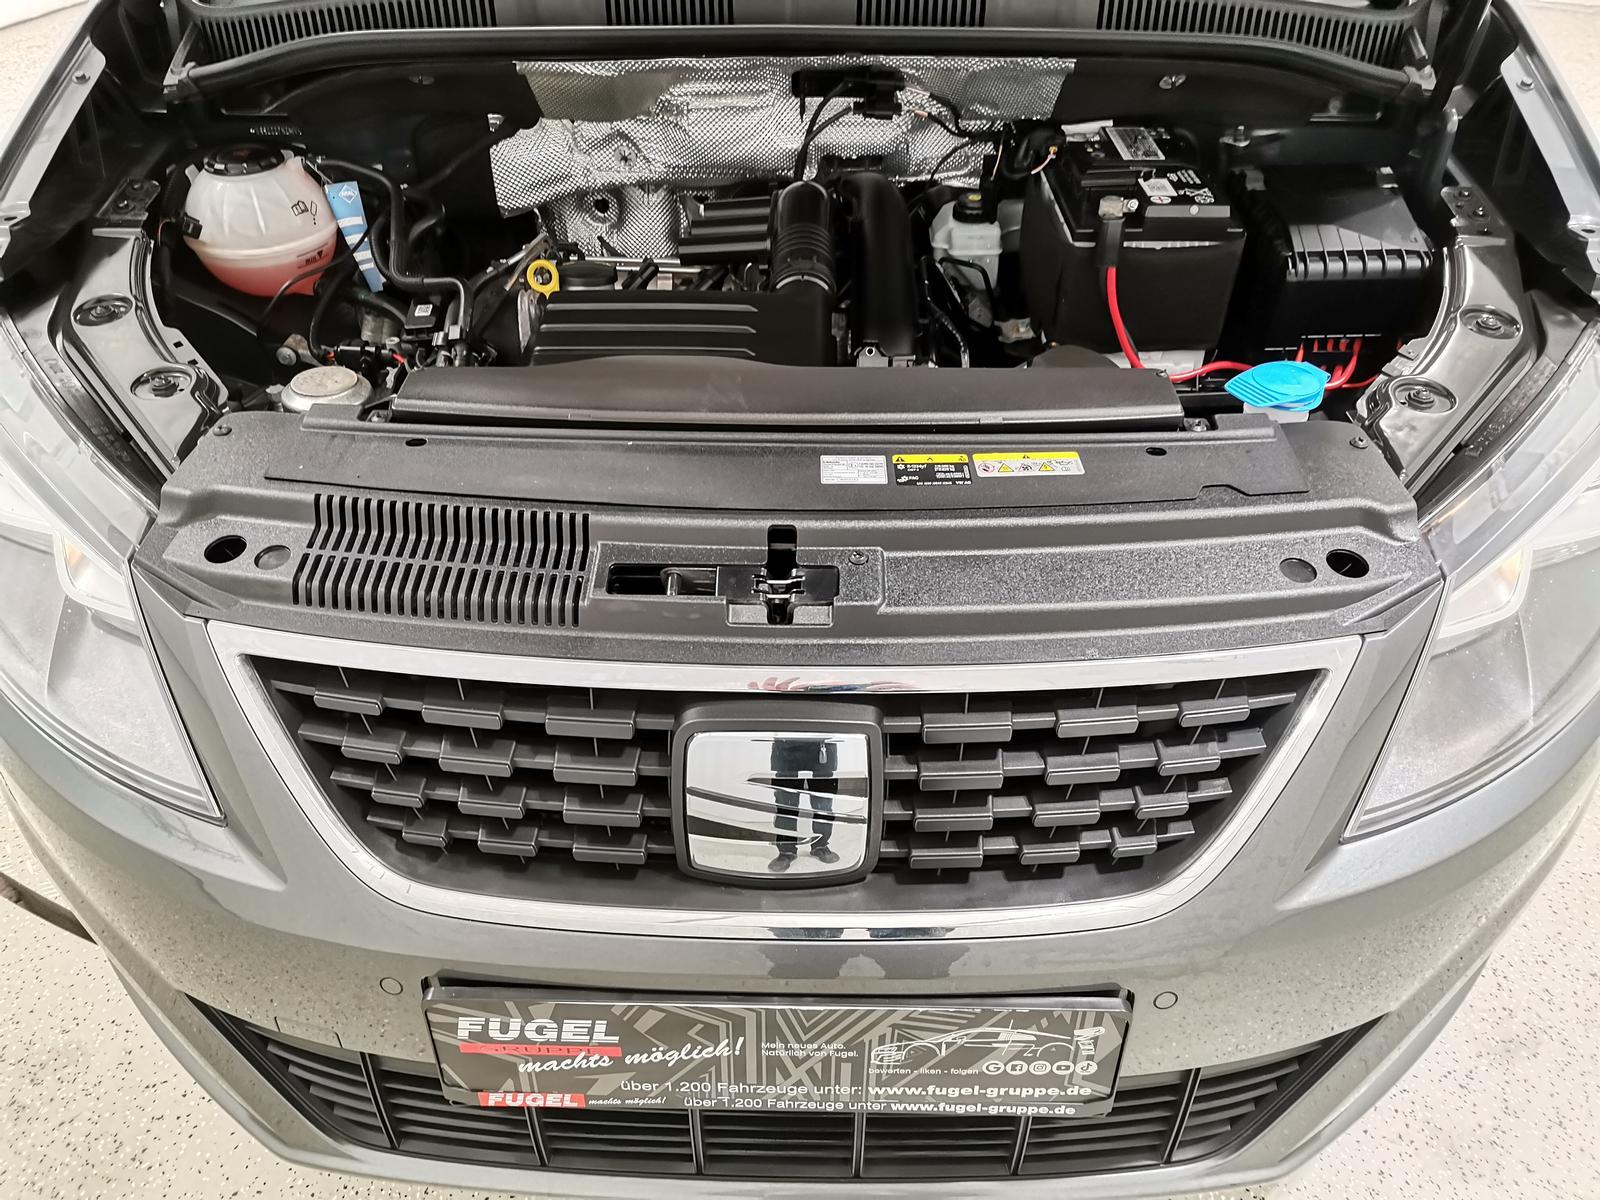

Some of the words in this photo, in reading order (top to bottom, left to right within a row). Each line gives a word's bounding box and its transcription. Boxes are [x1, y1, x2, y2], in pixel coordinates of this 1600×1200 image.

[457, 1016, 620, 1043] FUGEL
[518, 1051, 614, 1073] machts
[624, 1036, 745, 1067] möglich!
[829, 1050, 859, 1058] Fugel.
[868, 1067, 911, 1075] bewerten
[950, 1067, 979, 1076] folgen
[620, 1080, 659, 1091] über
[665, 1081, 711, 1092] 1.200
[717, 1082, 808, 1095] Fahrzeuge
[814, 1084, 862, 1095] unter:
[868, 1085, 1092, 1098] www.fugel-gruppe.de
[487, 1093, 579, 1106] FUGEL
[624, 1096, 667, 1106] möglich!
[683, 1096, 718, 1107] über
[721, 1097, 762, 1108] 1.200
[767, 1098, 844, 1111] Fahrzeuge
[848, 1101, 887, 1110] unter
[890, 1102, 1076, 1115] www.fugel-gruppe.de
